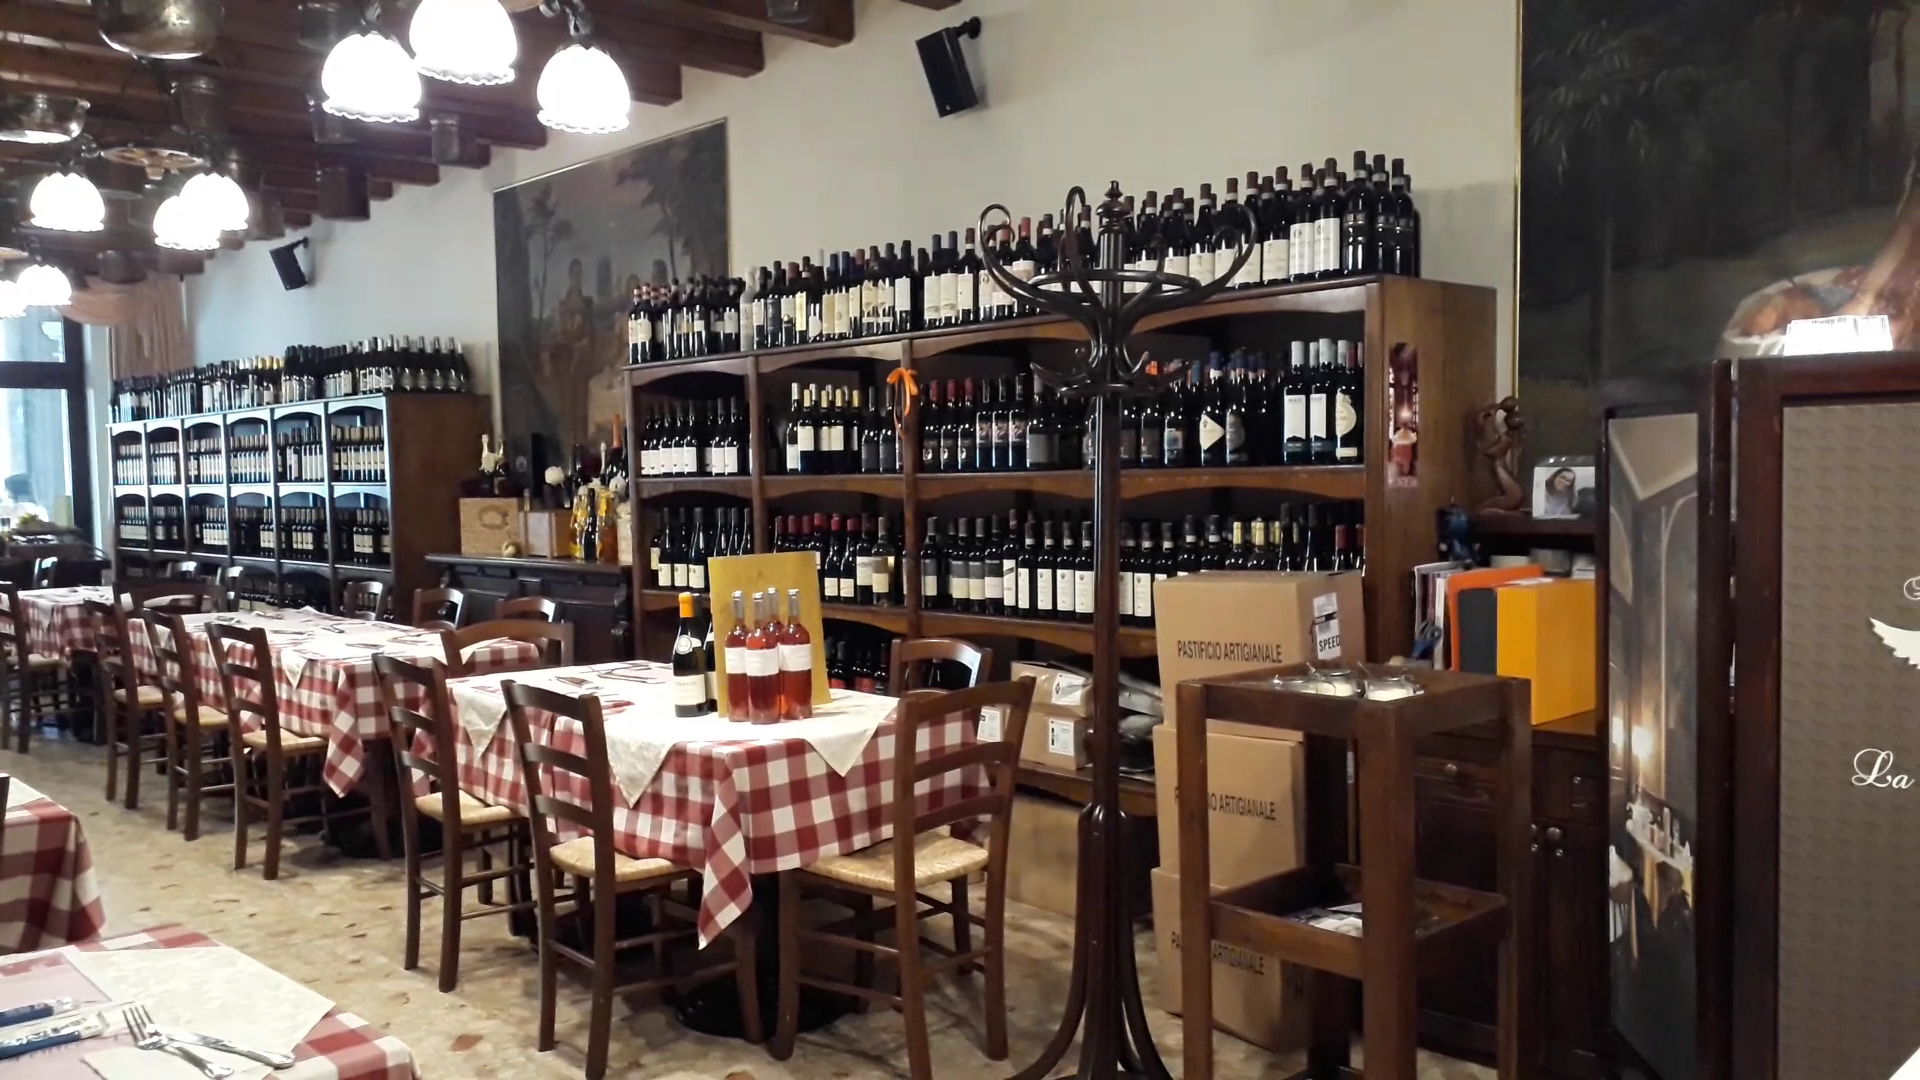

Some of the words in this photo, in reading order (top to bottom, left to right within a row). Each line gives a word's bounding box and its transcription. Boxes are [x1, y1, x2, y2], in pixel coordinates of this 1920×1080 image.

[1177, 640, 1221, 660] PASTIFICIO
[1224, 642, 1282, 663] ARTIGIANALE
[1319, 635, 1340, 652] SPEED
[1851, 748, 1915, 789] La
[1219, 794, 1276, 820] ARTIGIANALE
